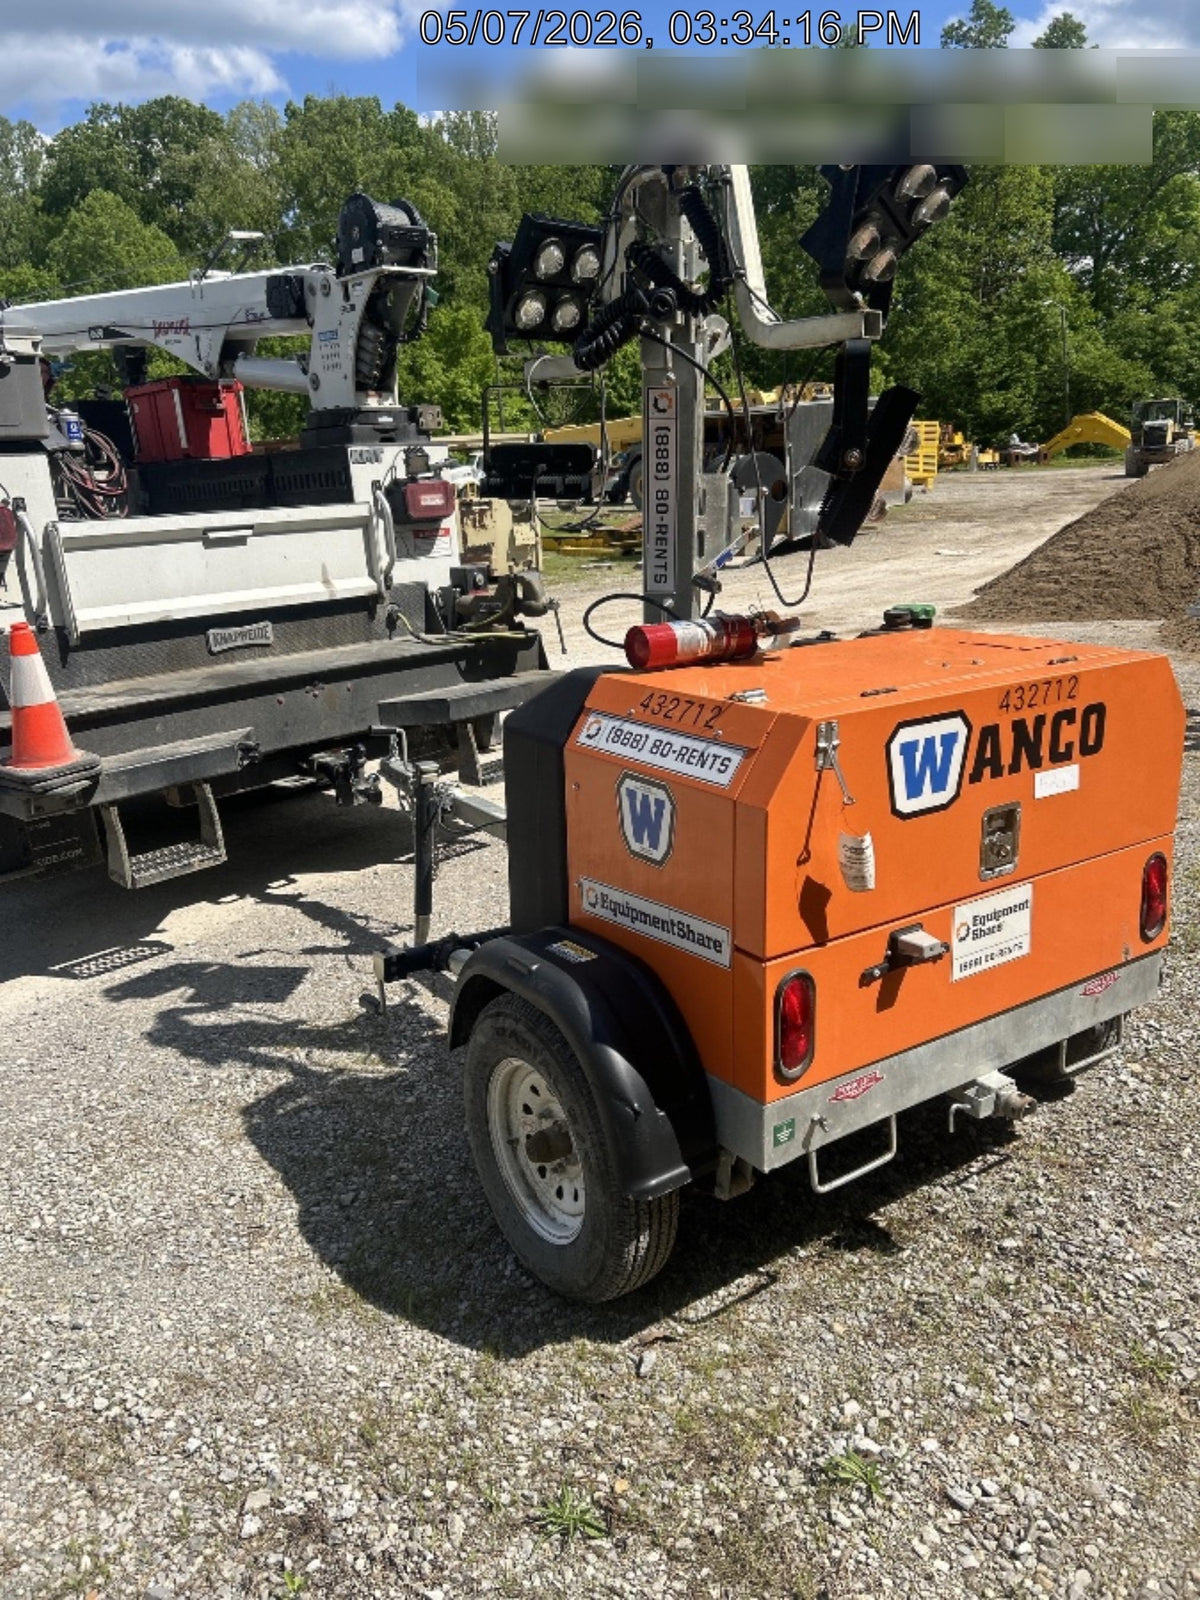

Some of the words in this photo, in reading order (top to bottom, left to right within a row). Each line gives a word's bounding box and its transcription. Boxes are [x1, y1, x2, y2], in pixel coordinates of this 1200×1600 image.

[654, 425, 671, 481] (888)
[654, 489, 669, 584] 80-RENTS
[639, 692, 726, 729] 432712
[1000, 675, 1079, 713] 432712
[605, 725, 649, 752] (888)
[649, 738, 732, 774] 80-RENTS
[899, 701, 1107, 801] WANCO
[625, 786, 666, 850] W
[600, 891, 723, 954] EquipmentShare
[972, 899, 1030, 927] Equipment
[972, 922, 1003, 941] Share
